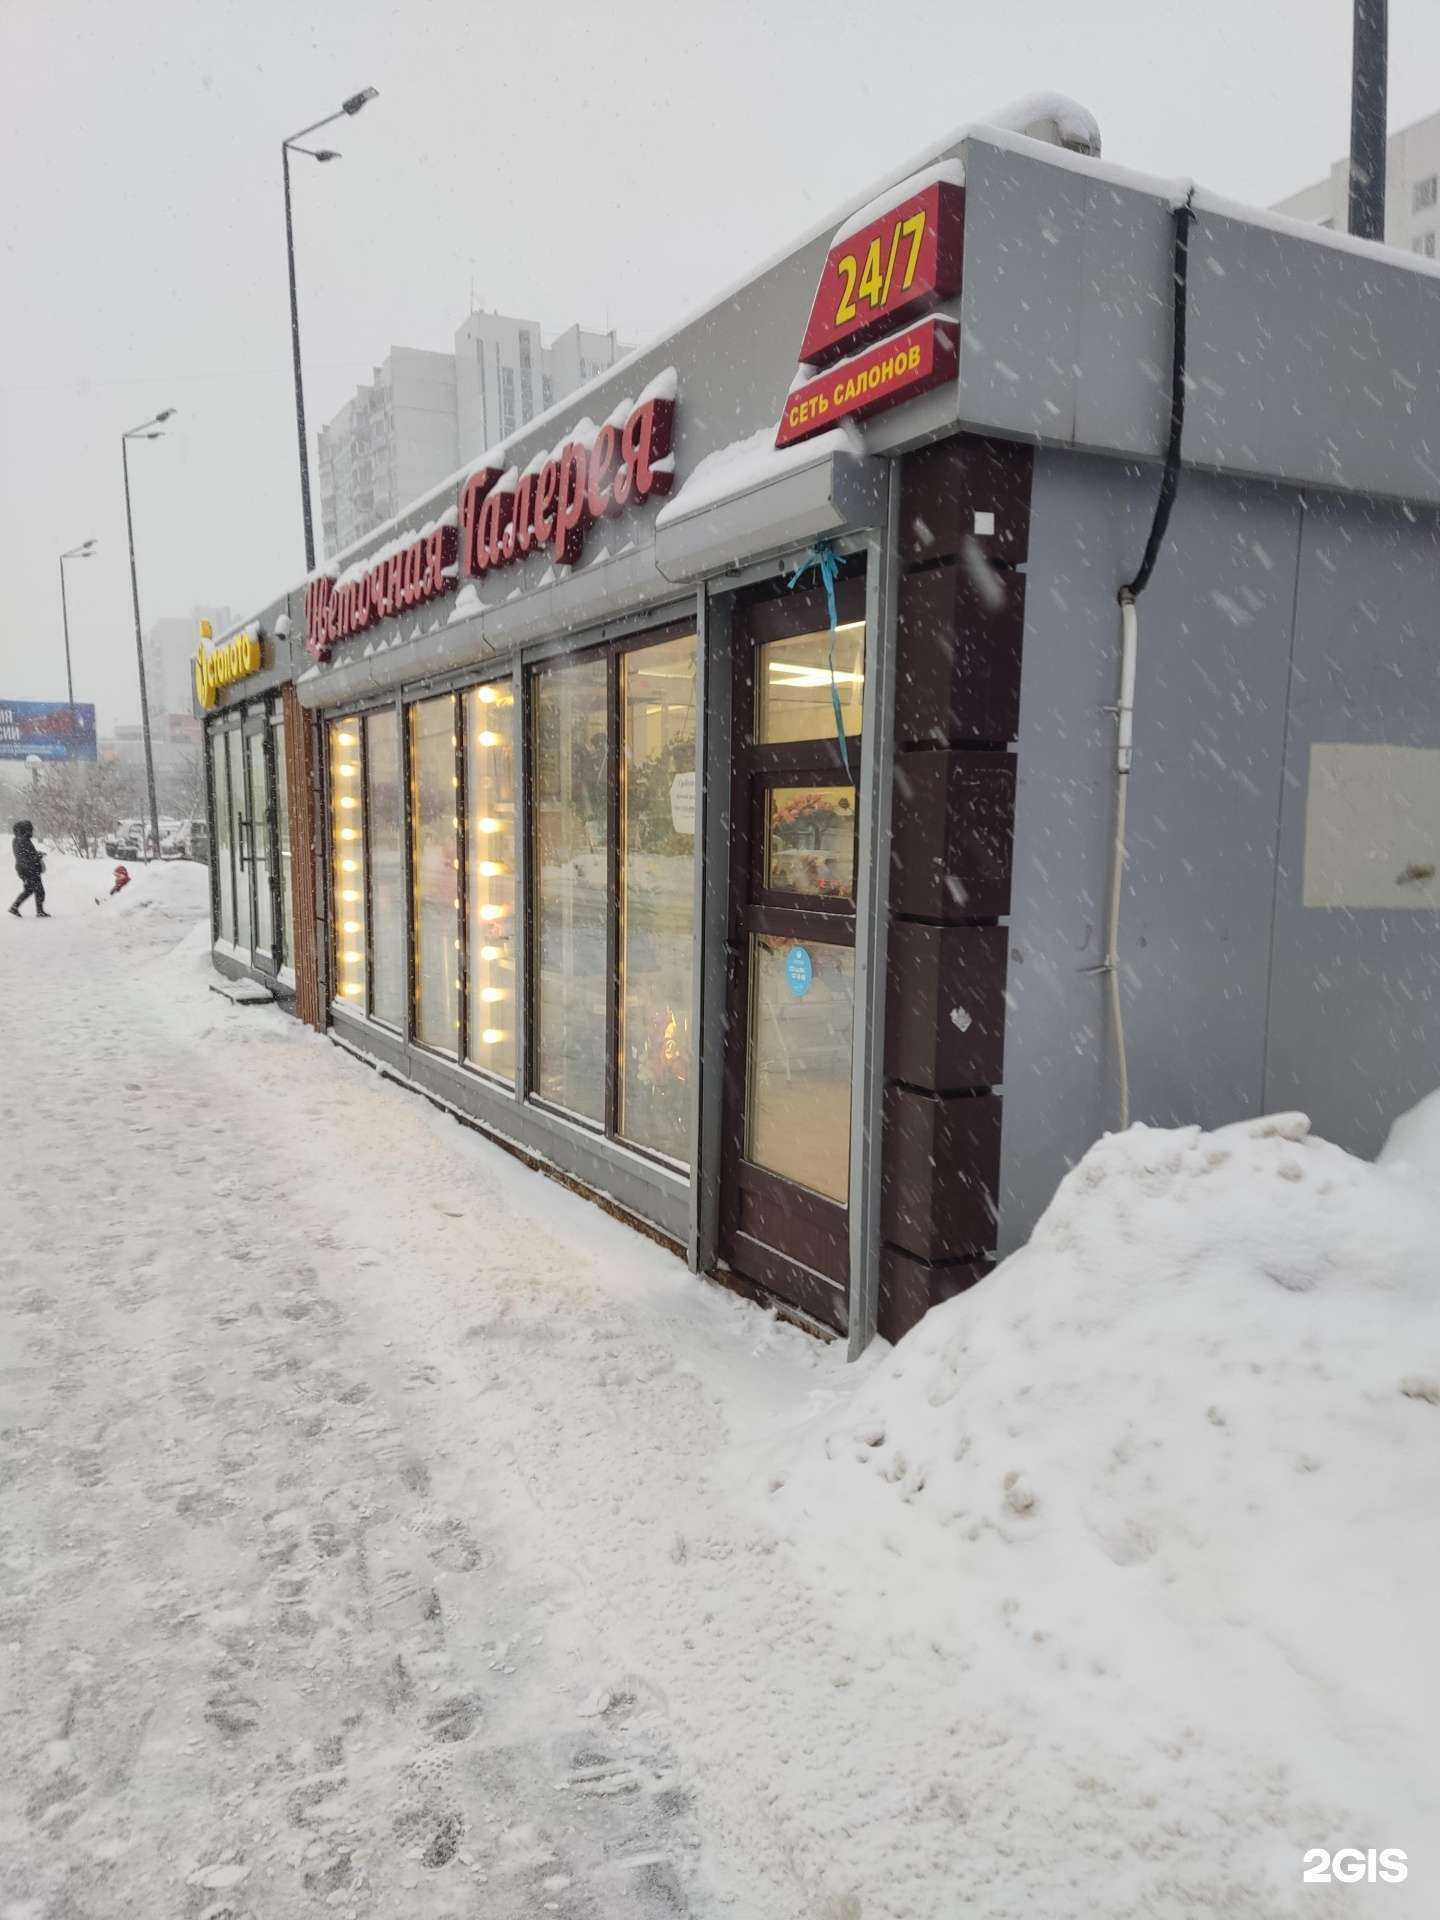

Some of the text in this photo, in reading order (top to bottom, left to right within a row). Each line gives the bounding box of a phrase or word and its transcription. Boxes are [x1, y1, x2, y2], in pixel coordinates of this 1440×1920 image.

[835, 210, 926, 326] 24/7
[788, 345, 921, 428] СЕТЬ САЛОНОВ
